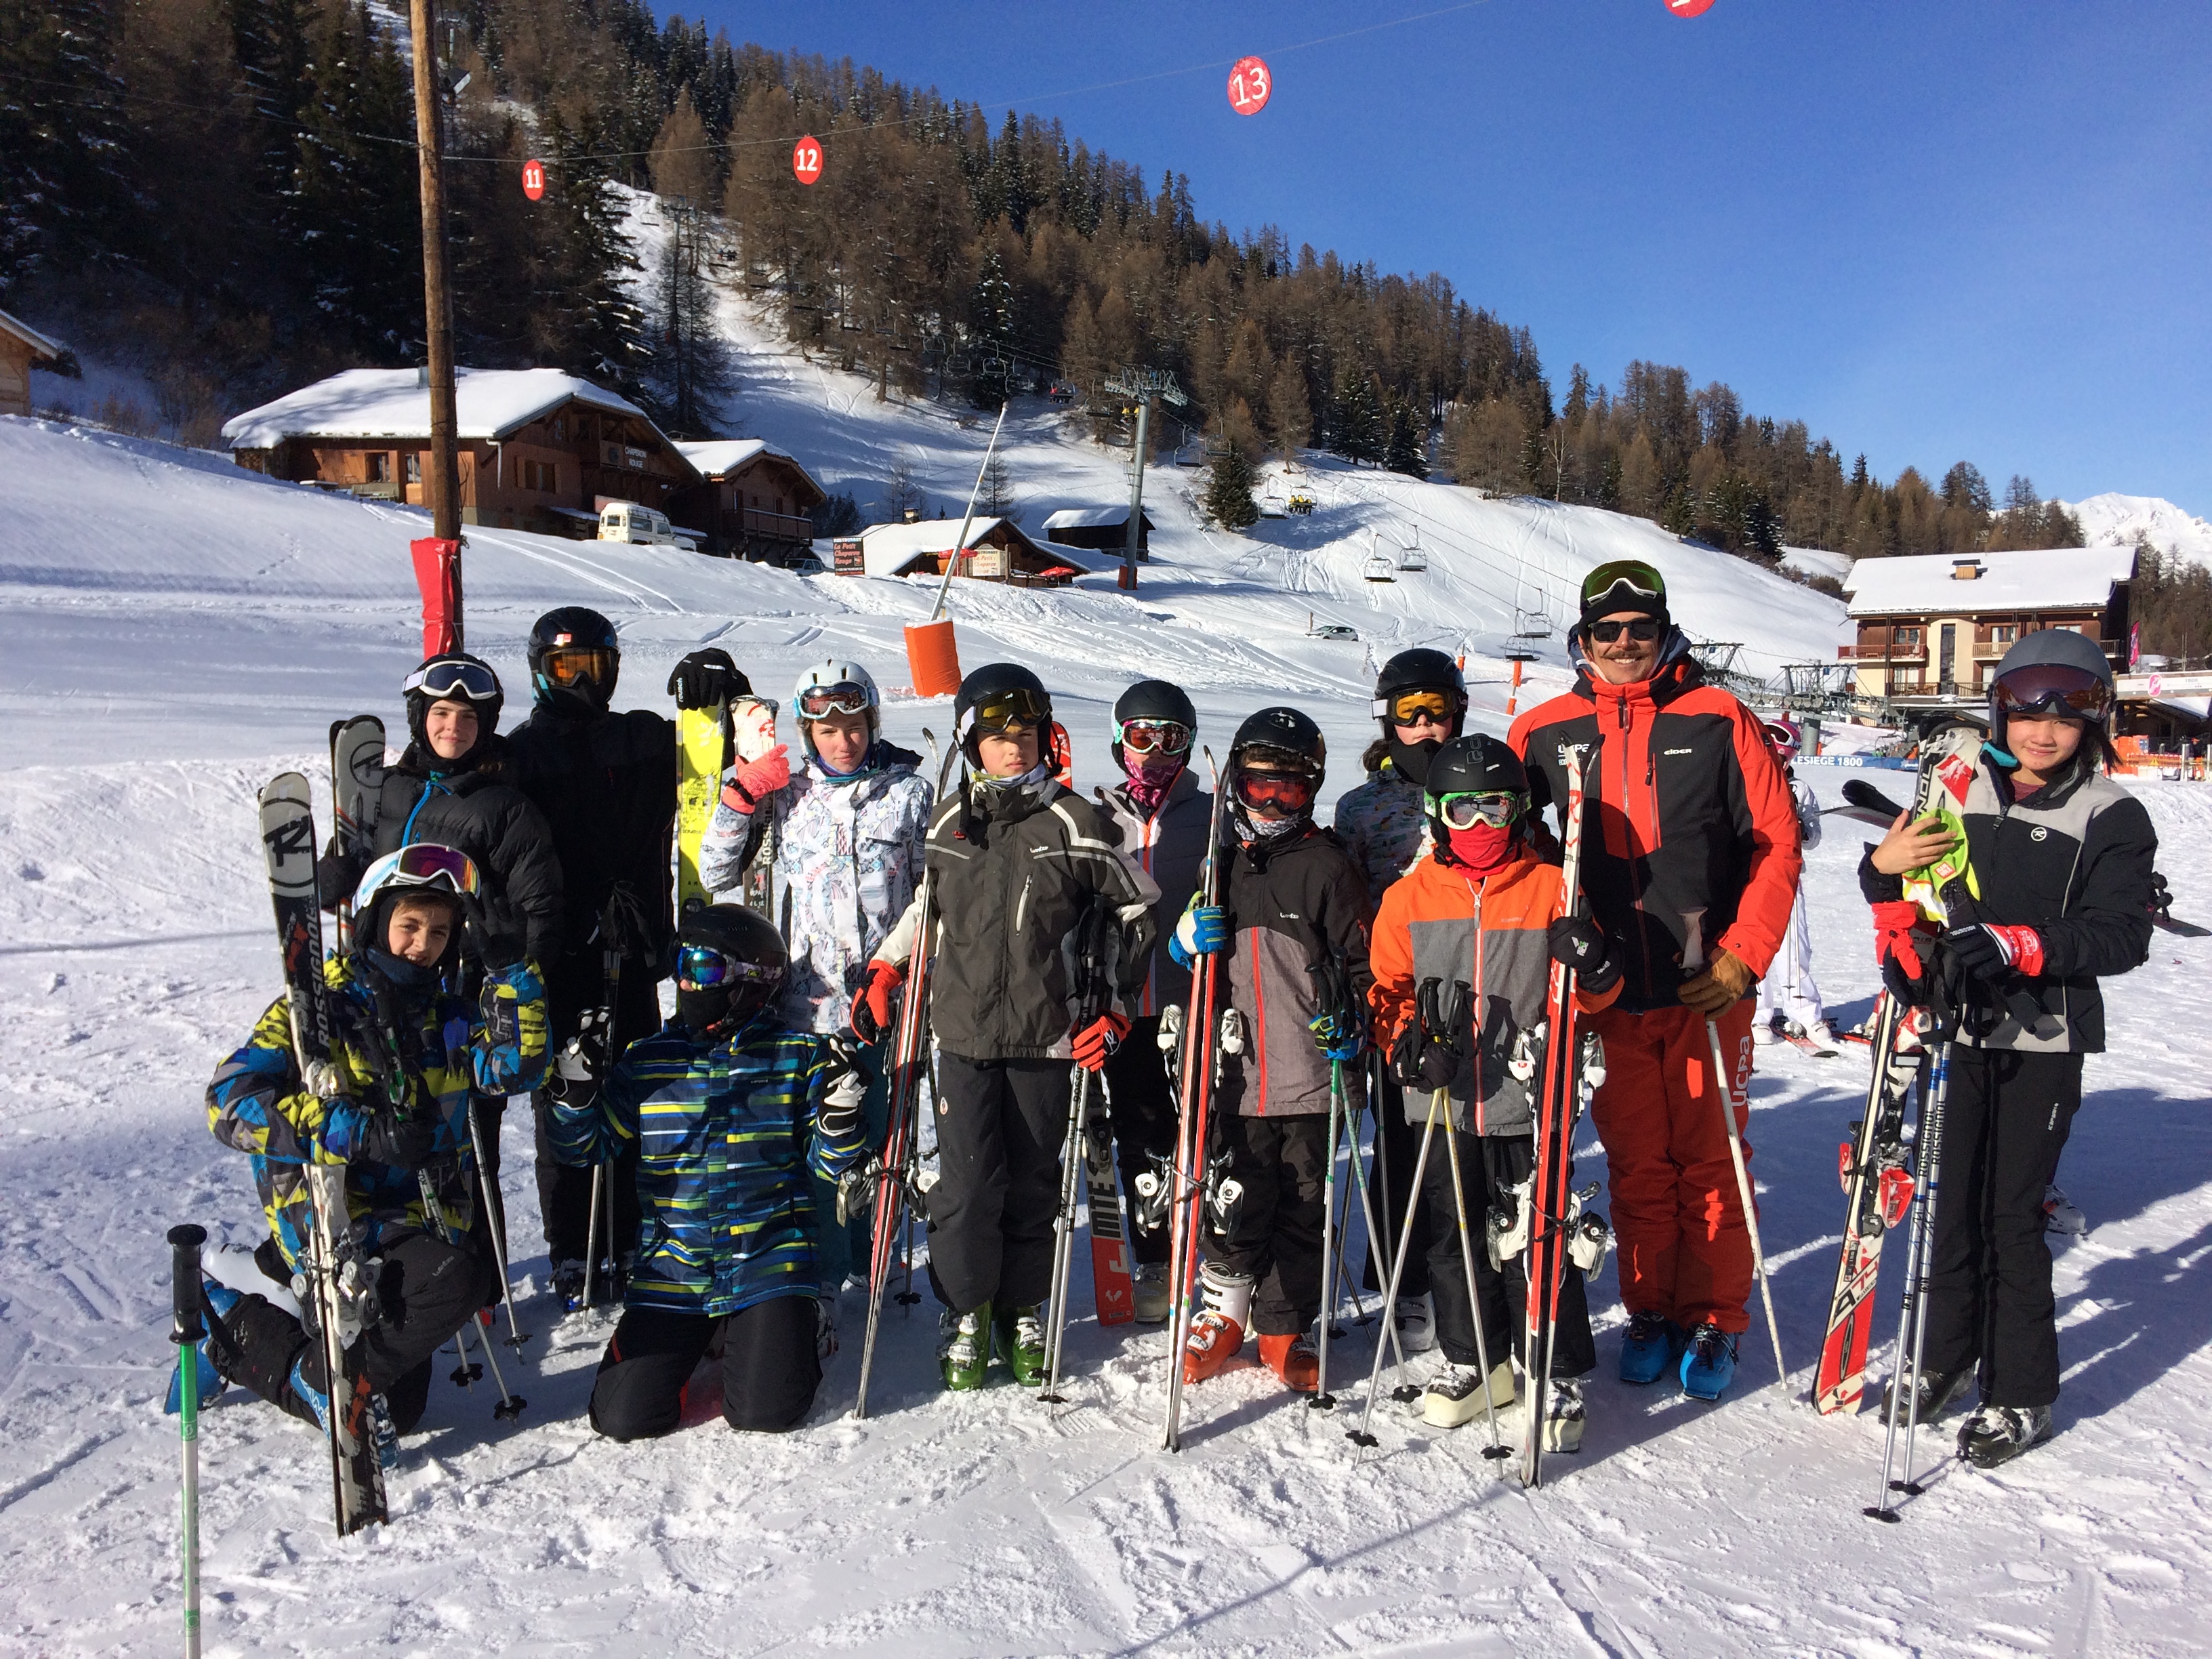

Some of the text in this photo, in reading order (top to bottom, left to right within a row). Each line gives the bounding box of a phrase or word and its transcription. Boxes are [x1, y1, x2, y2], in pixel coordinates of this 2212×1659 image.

[1233, 67, 1267, 106] 13
[797, 148, 817, 171] 12
[526, 169, 541, 188] 11
[1837, 757, 1863, 766] 1800
[306, 907, 329, 1048] ROSSIGNOL
